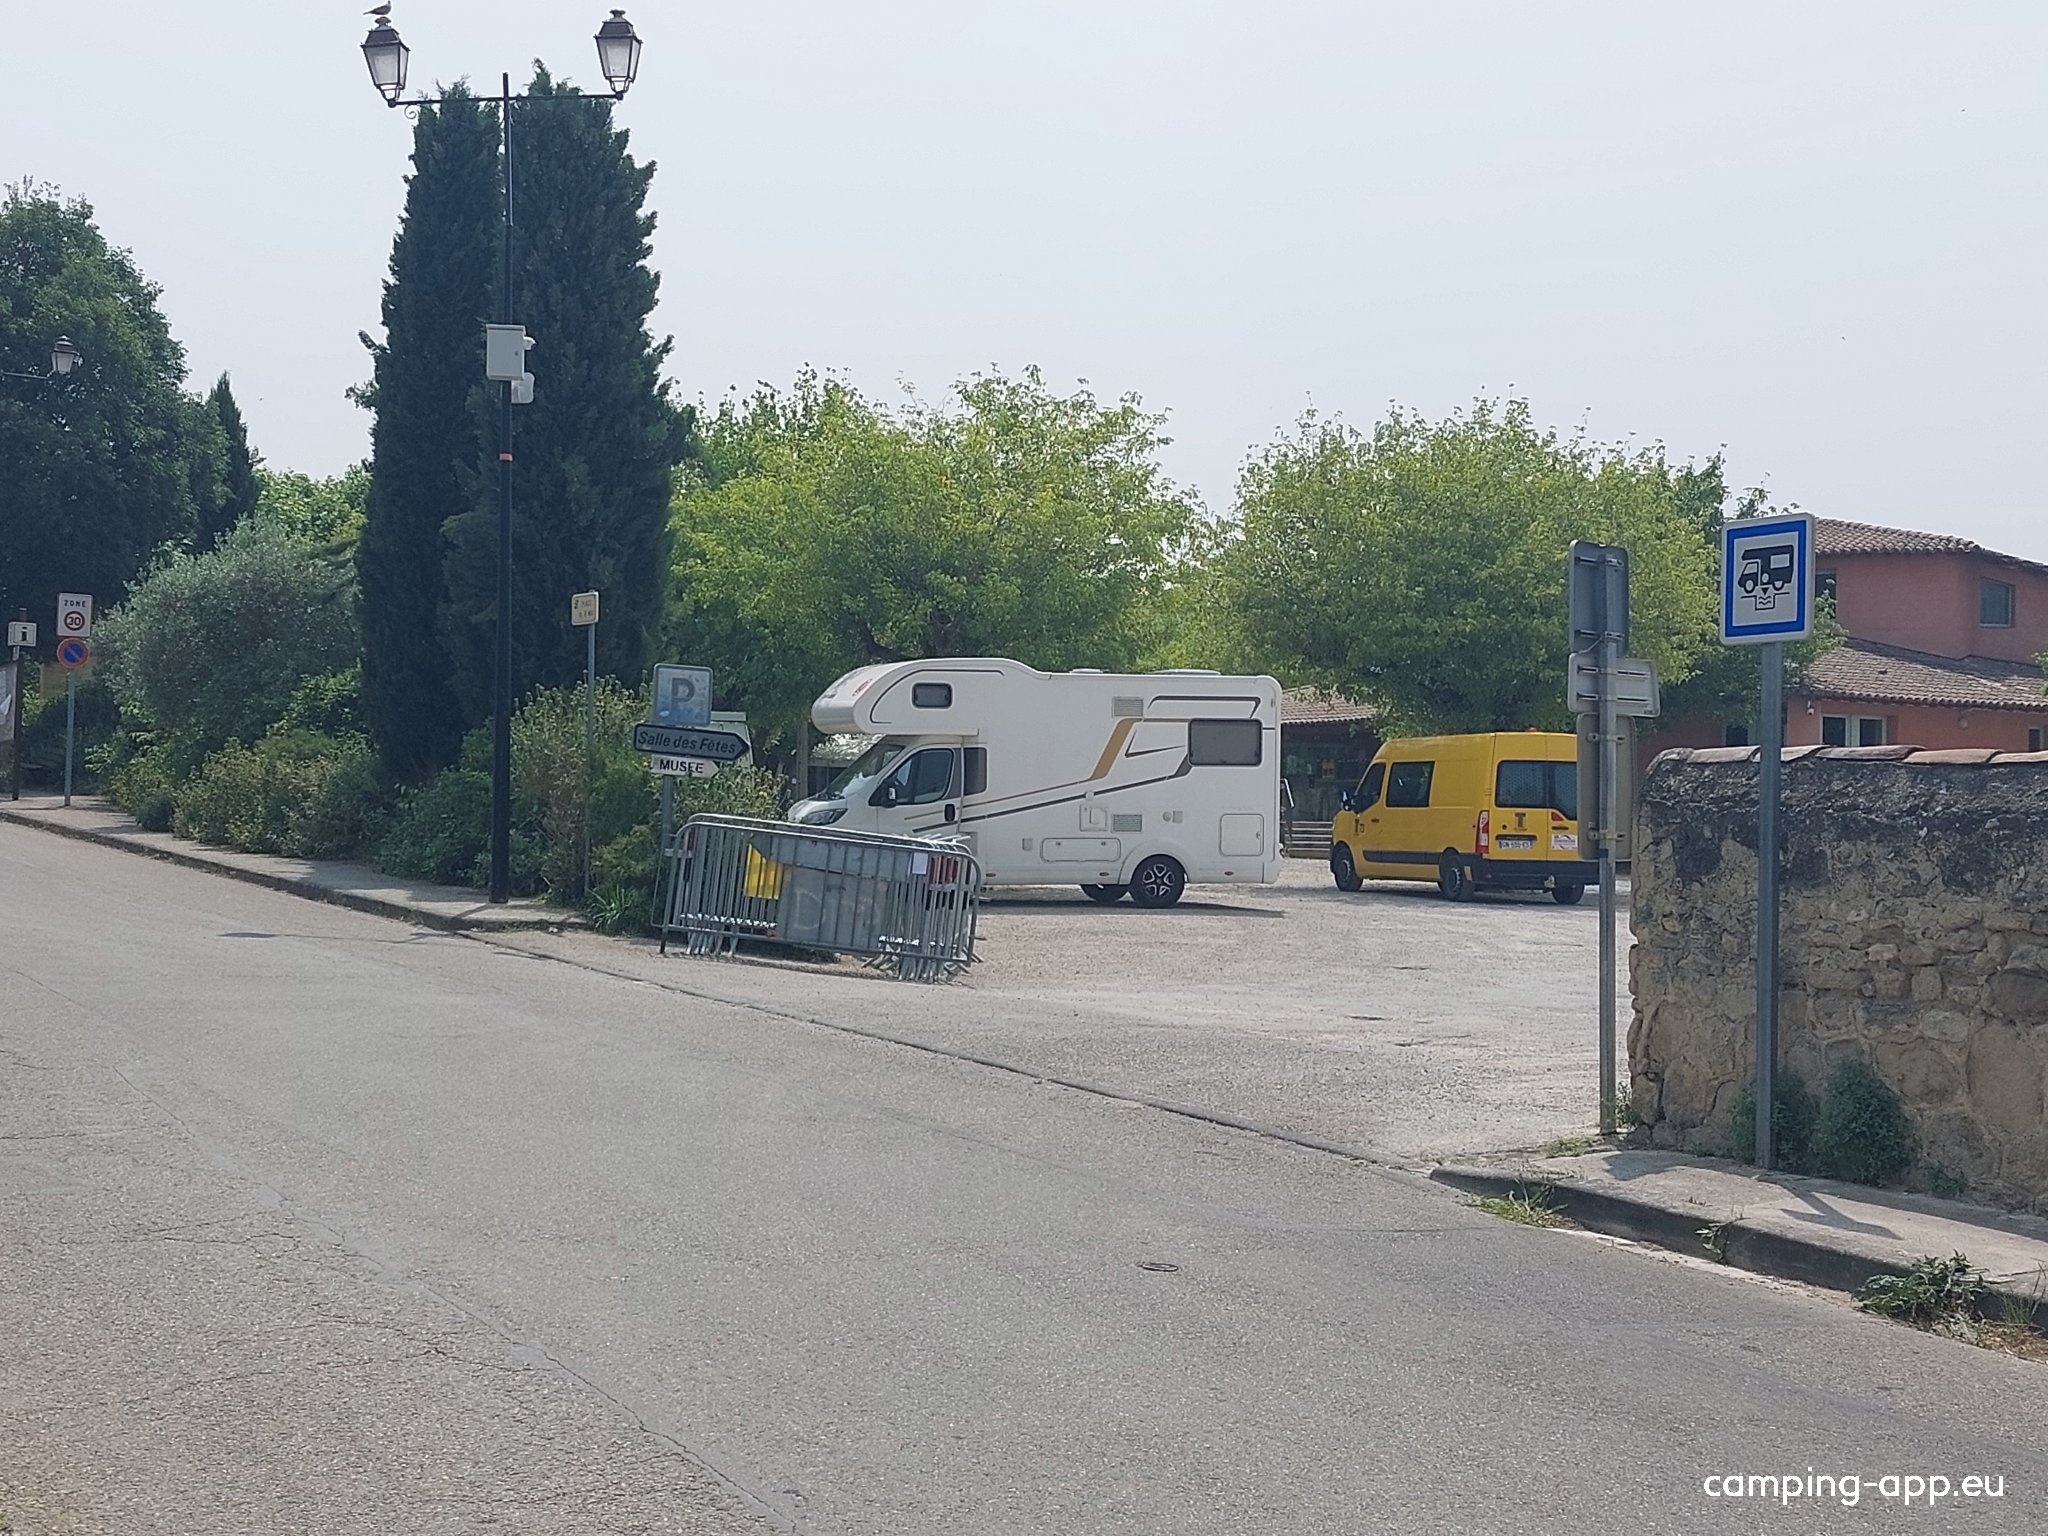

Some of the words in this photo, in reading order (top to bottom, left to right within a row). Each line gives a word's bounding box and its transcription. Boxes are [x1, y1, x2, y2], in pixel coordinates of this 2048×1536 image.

[63, 599, 87, 608] ZONE
[67, 616, 82, 627] 30
[670, 677, 696, 712] P
[637, 730, 671, 747] Salle
[673, 735, 698, 750] des
